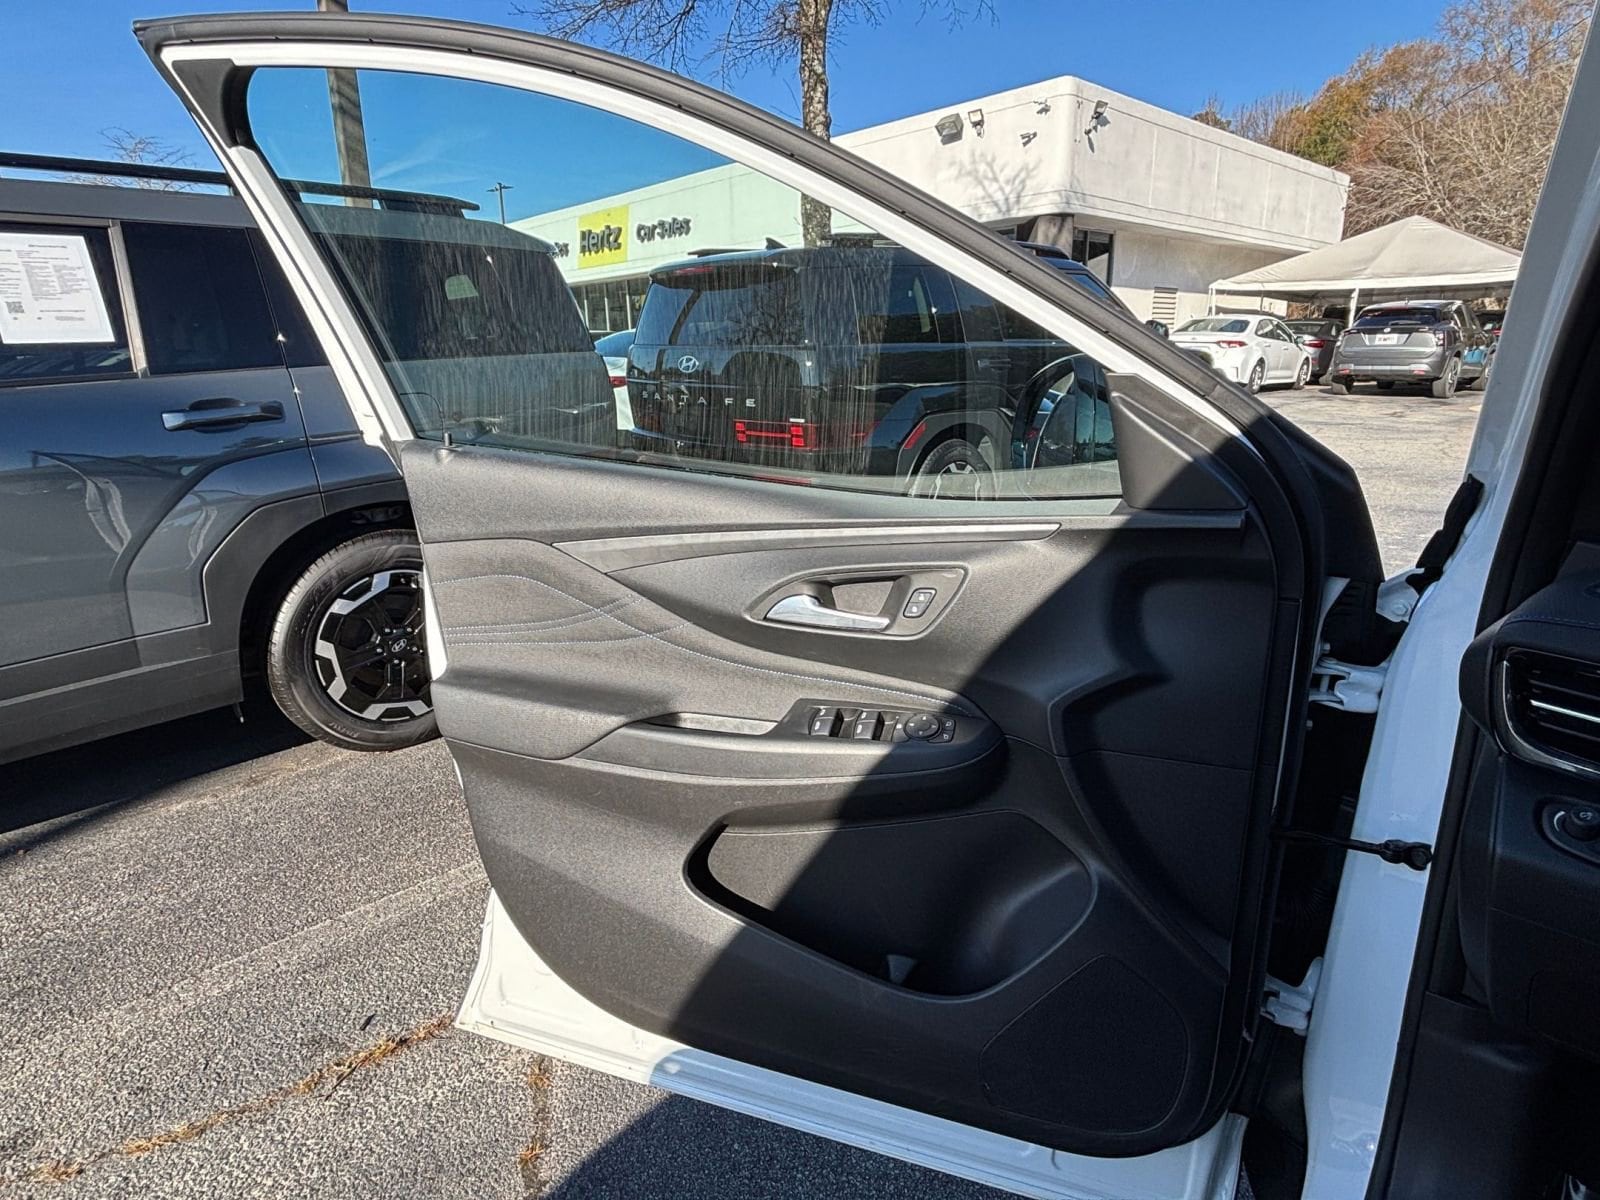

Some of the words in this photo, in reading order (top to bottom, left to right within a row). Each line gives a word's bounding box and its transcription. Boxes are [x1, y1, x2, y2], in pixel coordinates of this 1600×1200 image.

[657, 216, 692, 240] Sales
[579, 224, 623, 257] Hertz
[642, 390, 708, 405] SANTA
[724, 397, 756, 408] FE
